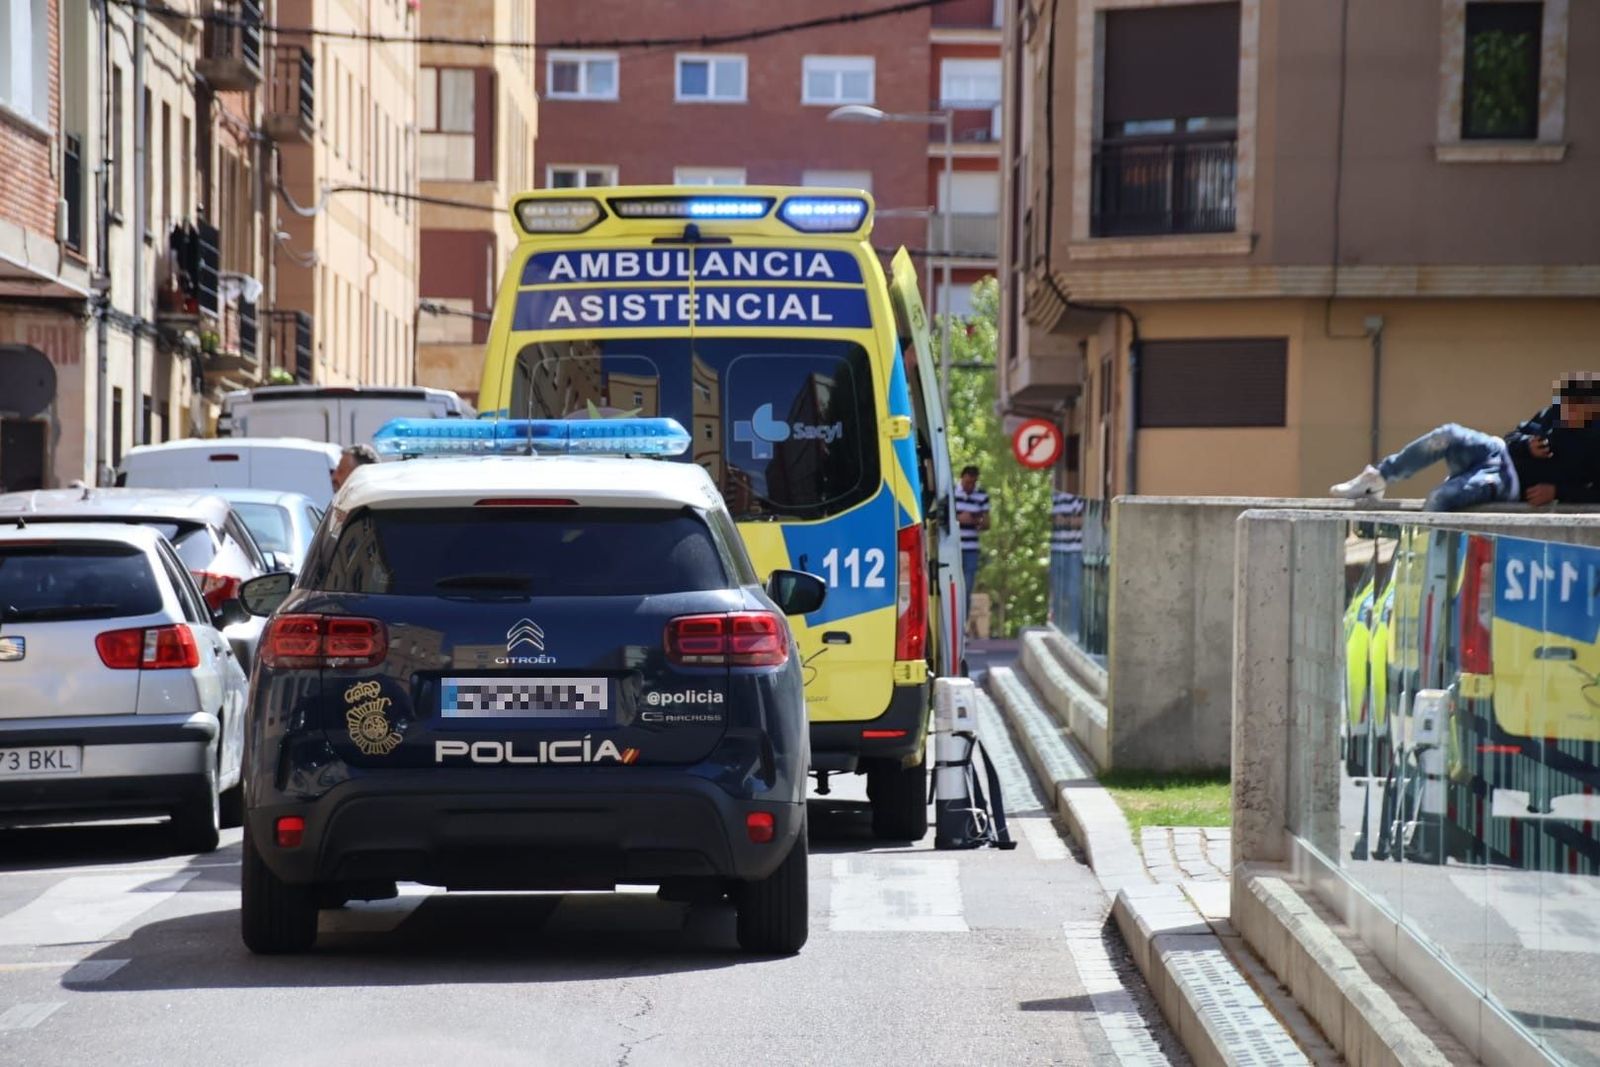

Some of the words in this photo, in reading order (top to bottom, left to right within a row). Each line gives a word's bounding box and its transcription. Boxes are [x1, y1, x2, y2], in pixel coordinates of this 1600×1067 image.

[548, 250, 835, 281] AMBULANCIA
[548, 292, 834, 323] ASISTENCIAL
[792, 421, 843, 444] Sacyl
[822, 548, 886, 589] 112
[495, 654, 557, 664] CITROËN
[647, 689, 724, 707] @policia
[29, 750, 73, 770] BKL
[435, 733, 622, 764] POLICÍA
